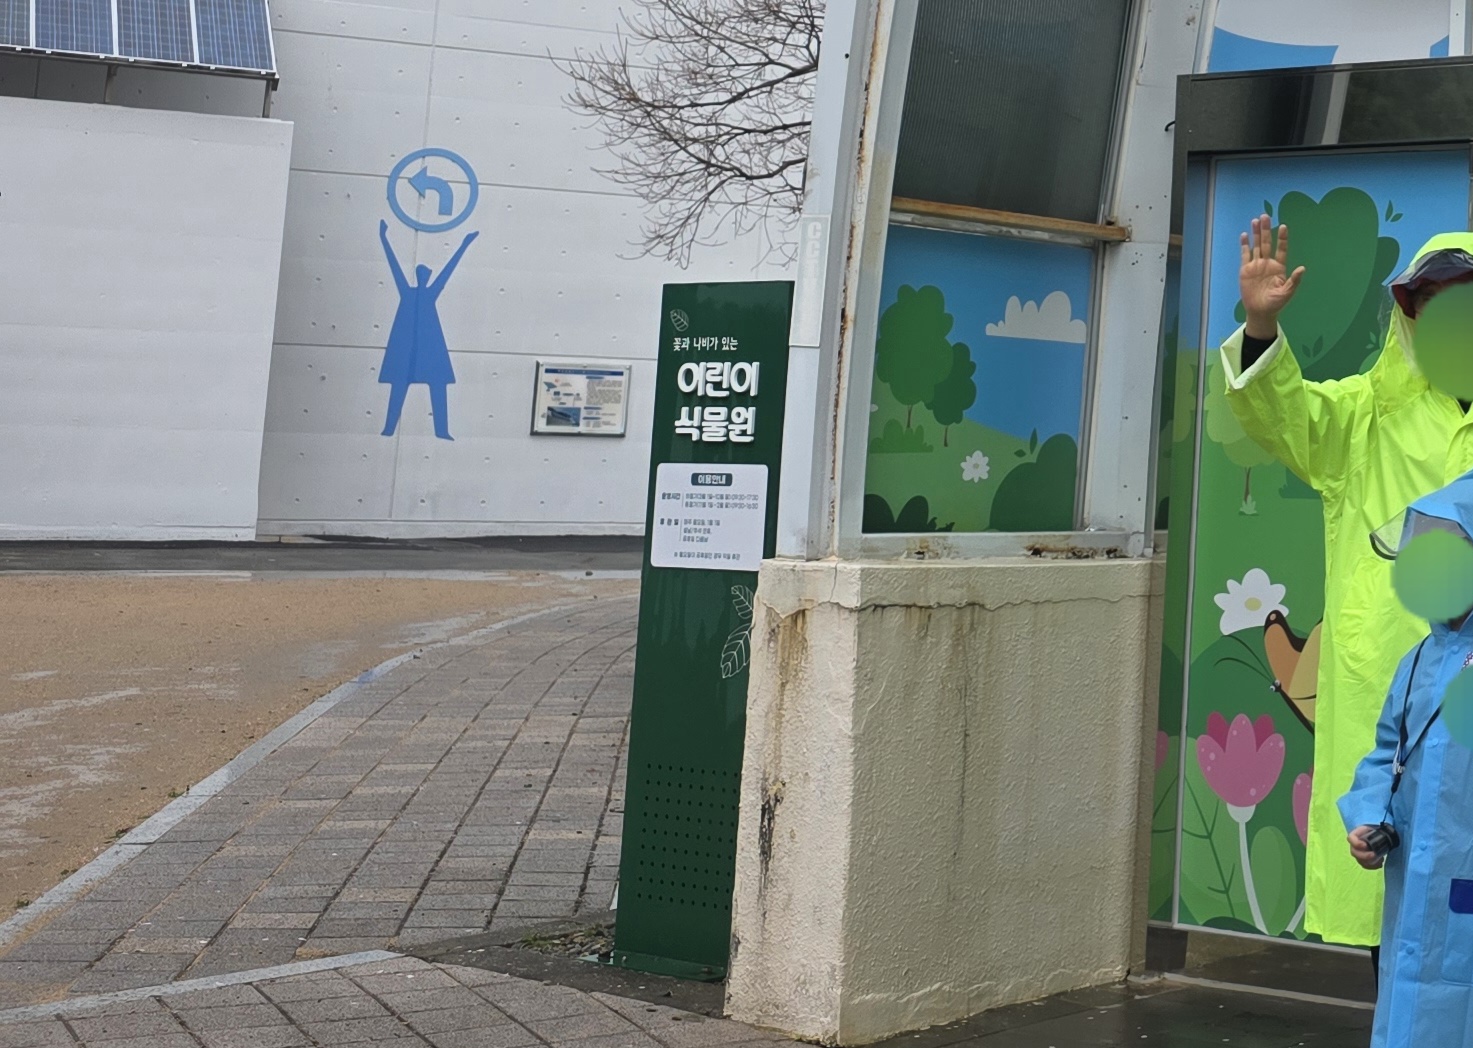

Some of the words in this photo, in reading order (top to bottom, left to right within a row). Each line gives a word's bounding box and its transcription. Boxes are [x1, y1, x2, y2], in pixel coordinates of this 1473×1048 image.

[673, 336, 690, 351] 꽃과
[693, 336, 719, 351] 나비가
[721, 336, 739, 351] 있는
[677, 361, 760, 397] 어린이
[674, 406, 756, 443] 식물원
